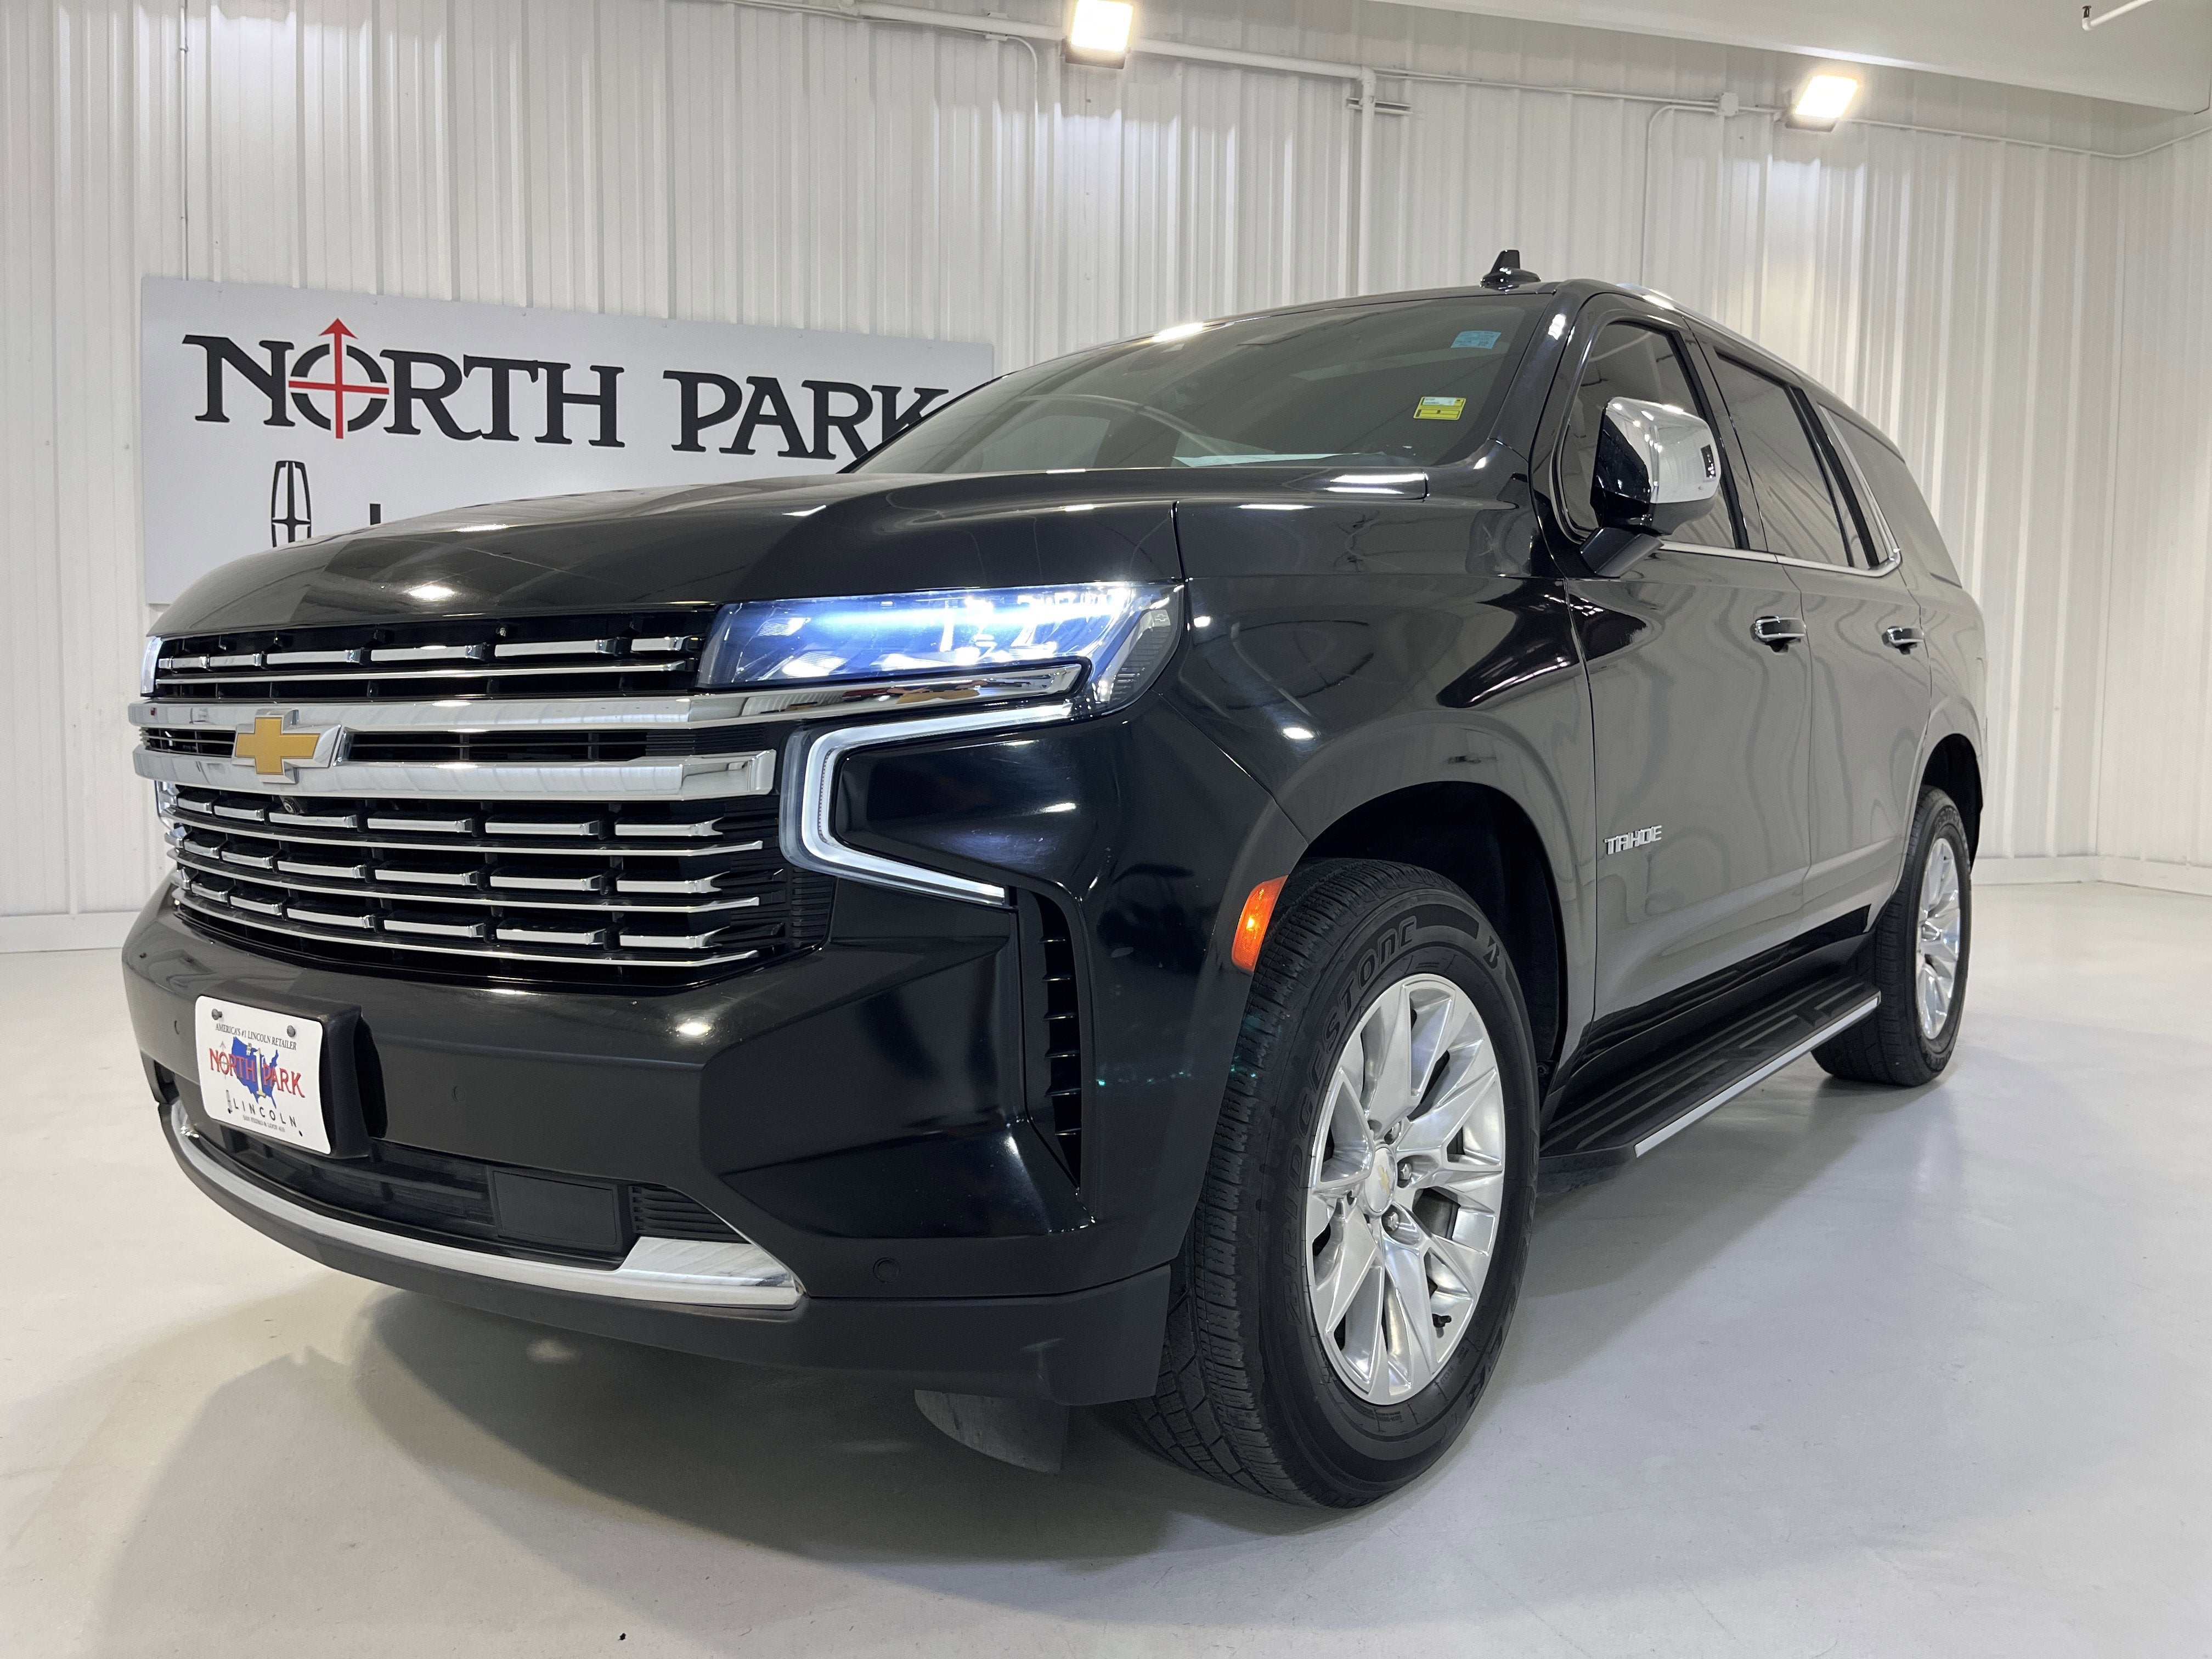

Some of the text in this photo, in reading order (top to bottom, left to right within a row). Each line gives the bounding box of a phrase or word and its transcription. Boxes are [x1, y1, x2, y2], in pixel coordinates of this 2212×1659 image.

[182, 334, 949, 460] NORTH PARK
[1604, 825, 1662, 855] TAHOE
[216, 1023, 240, 1036] AMERICA'S
[247, 1031, 271, 1043] LINCOLN
[272, 1036, 297, 1050] RETAILER
[209, 1048, 305, 1098] NORTH PARK
[233, 1098, 297, 1127] LINCOLN
